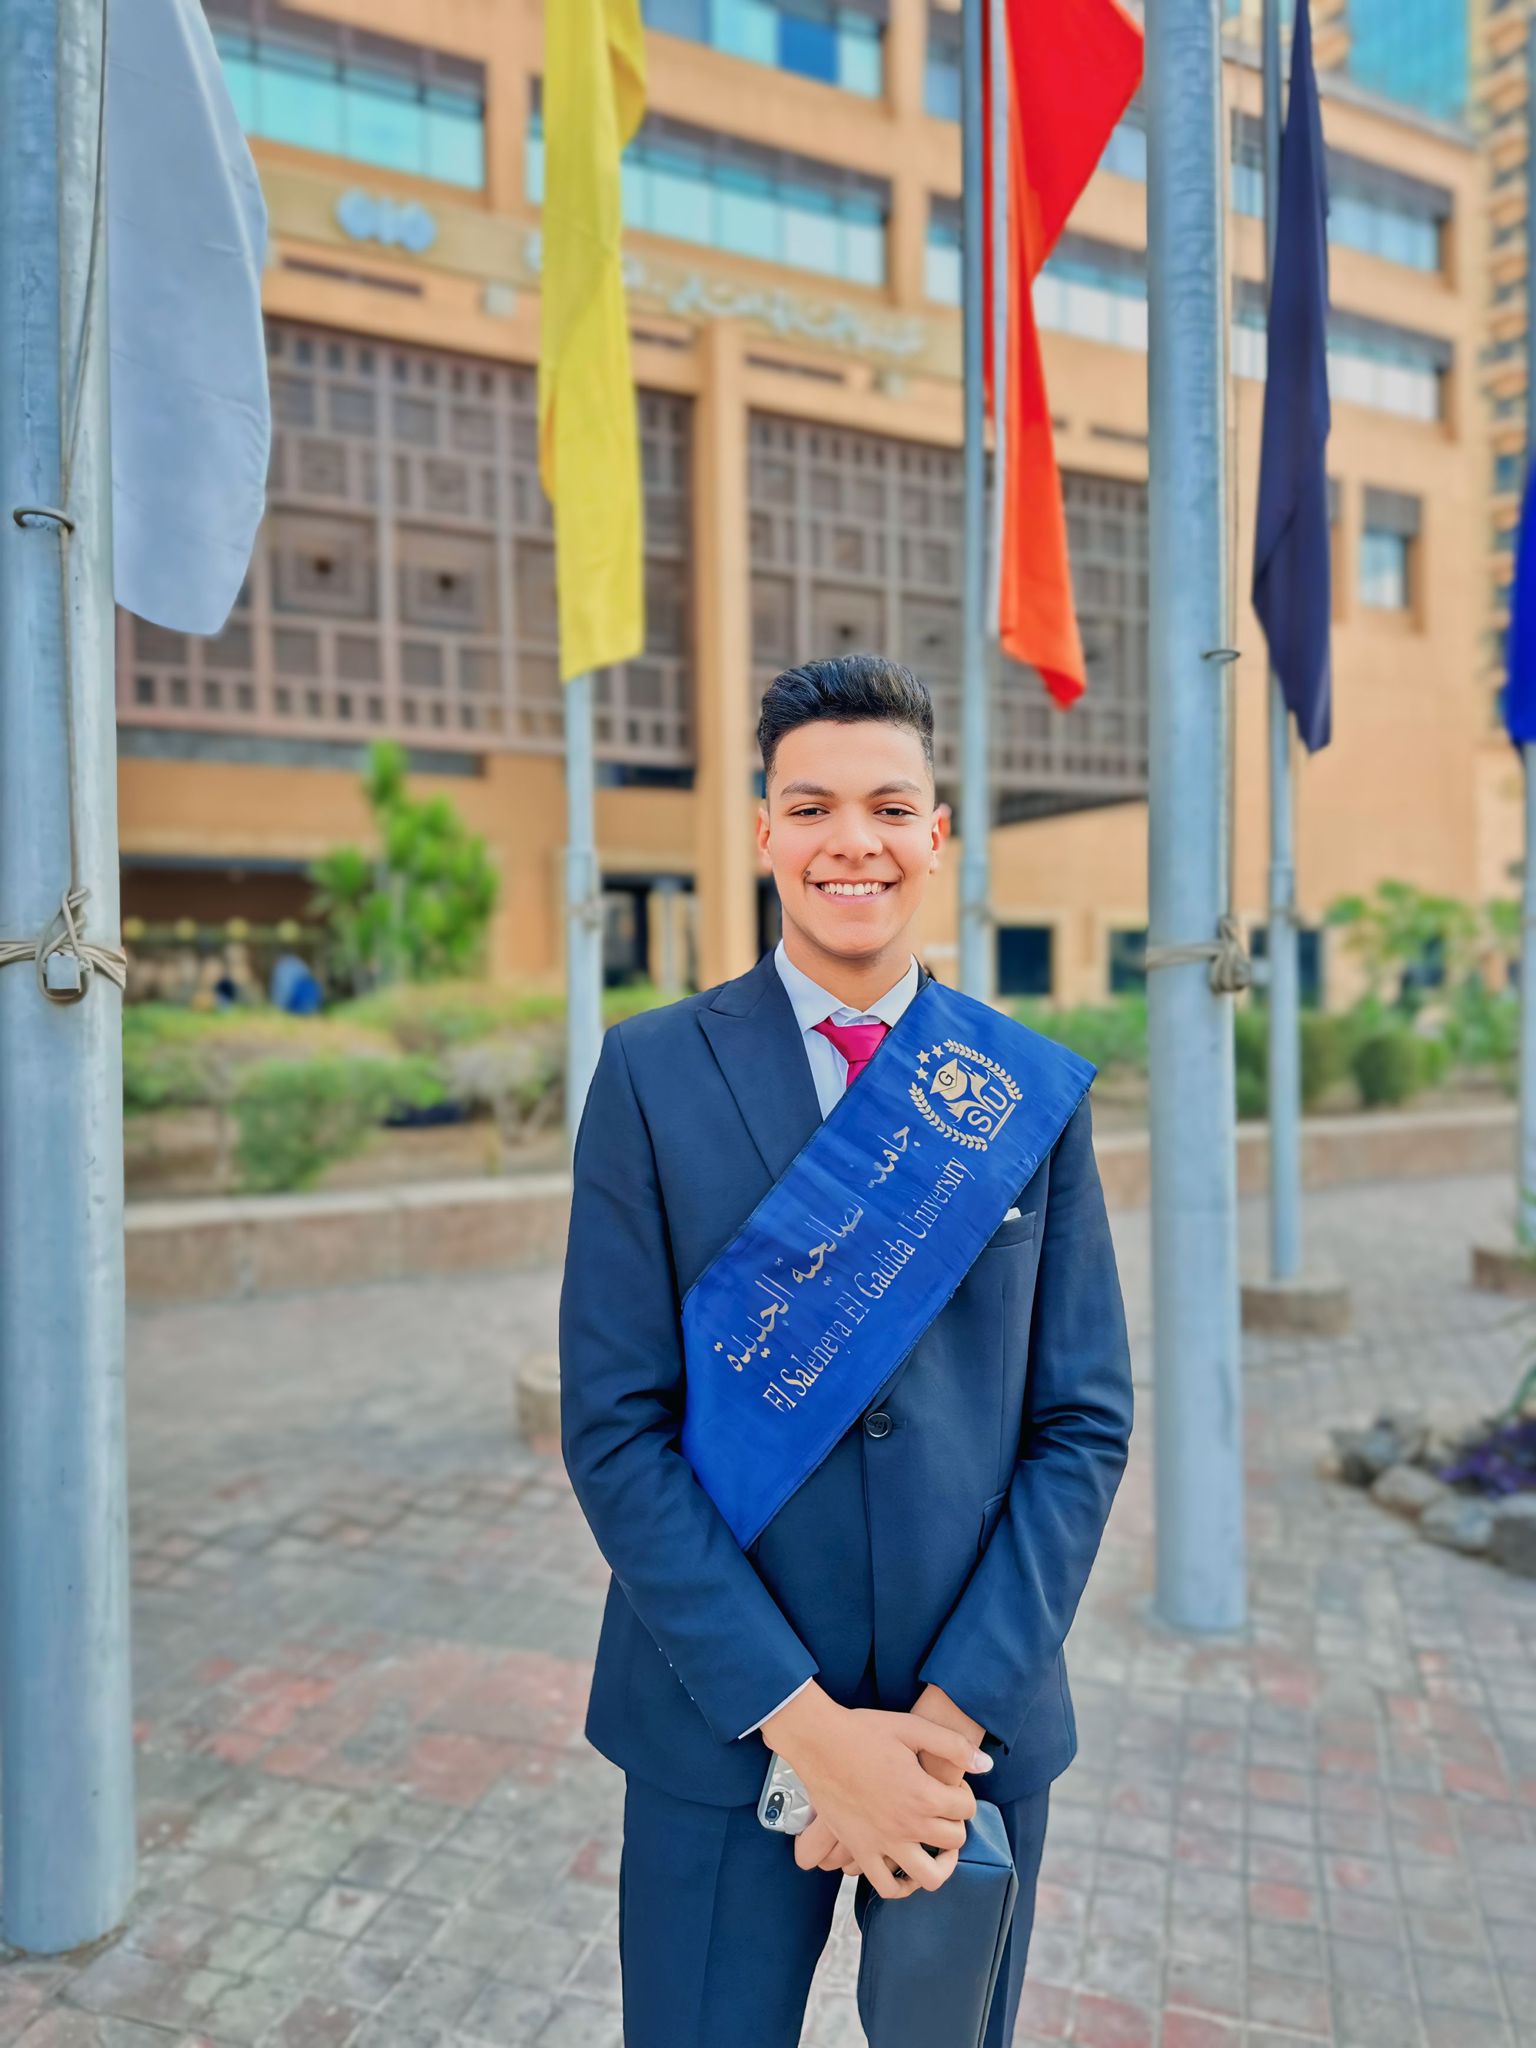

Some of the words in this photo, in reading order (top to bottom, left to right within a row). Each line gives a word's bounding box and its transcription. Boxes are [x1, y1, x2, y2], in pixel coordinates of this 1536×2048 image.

[938, 1070, 955, 1087] G
[898, 1157, 976, 1239] University
[854, 1240, 916, 1300] Gadida
[714, 1274, 796, 1373] الجديدة
[835, 1290, 870, 1326] El
[779, 1318, 852, 1397] Saleheya
[762, 1381, 798, 1413] El
